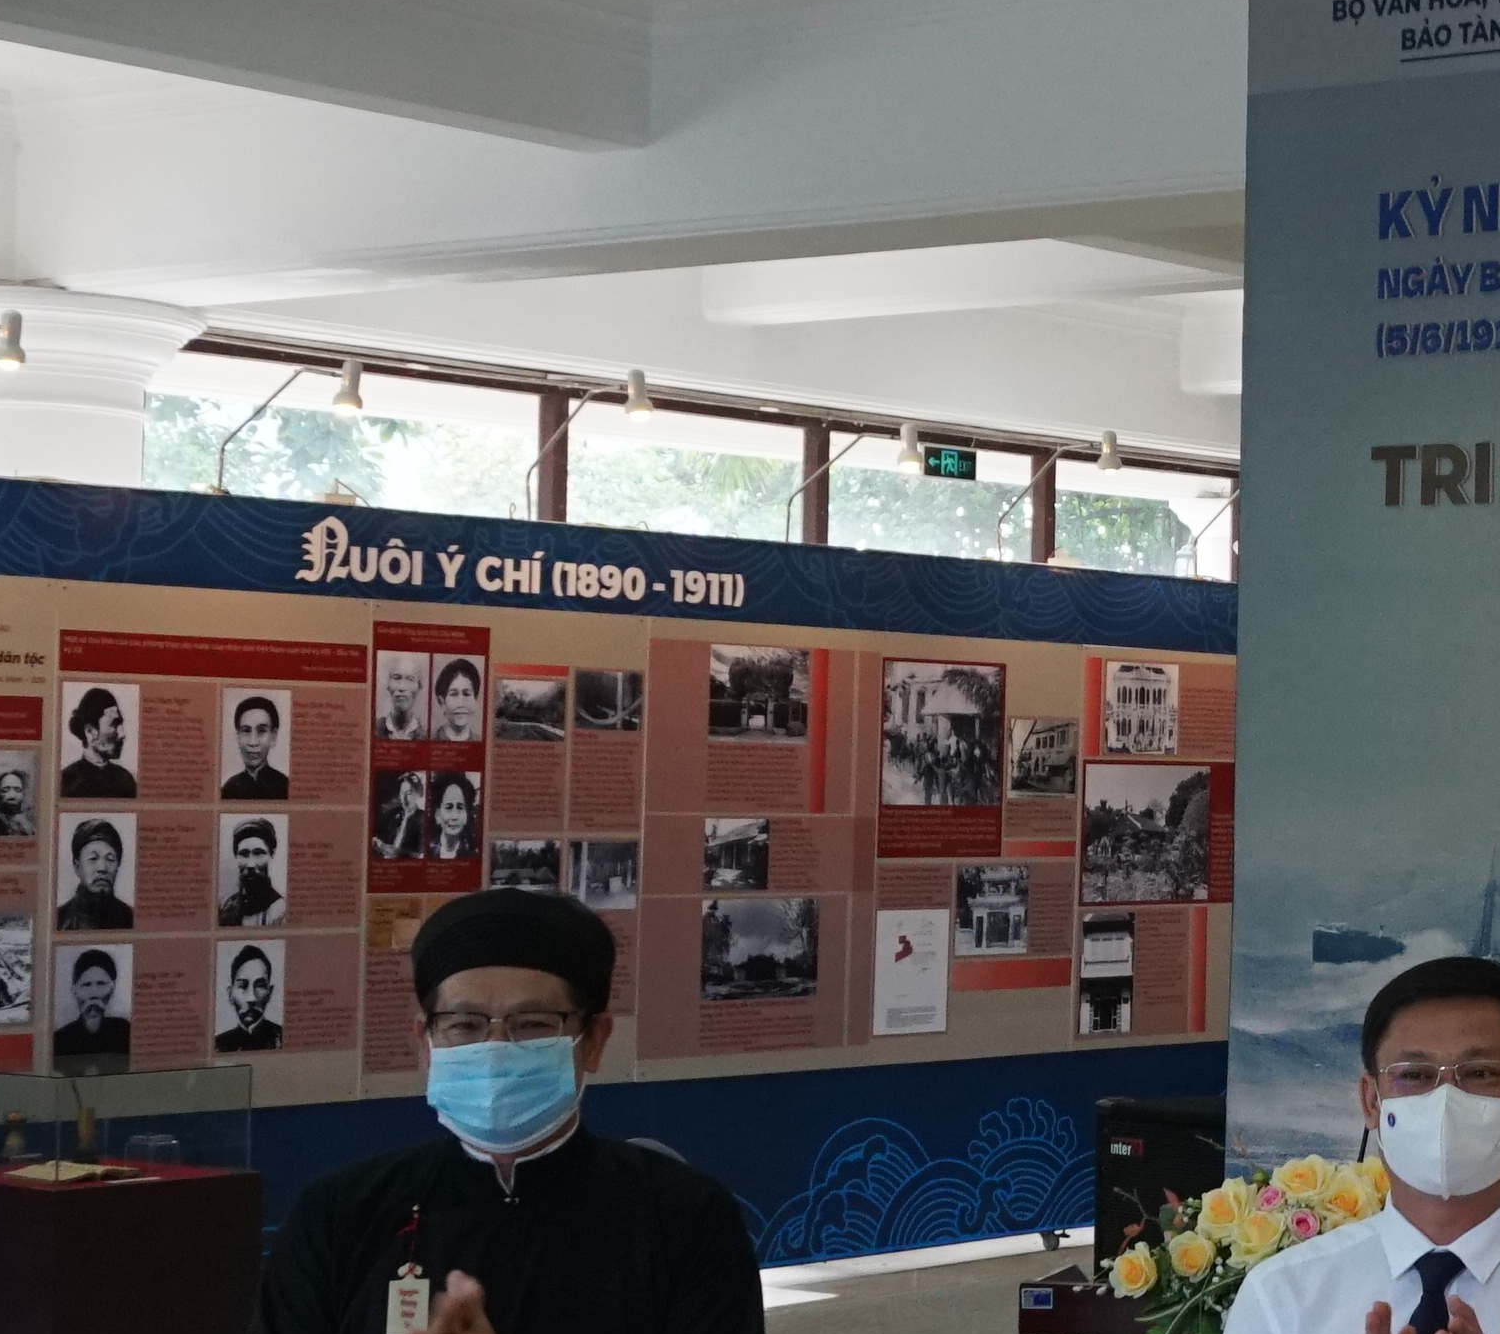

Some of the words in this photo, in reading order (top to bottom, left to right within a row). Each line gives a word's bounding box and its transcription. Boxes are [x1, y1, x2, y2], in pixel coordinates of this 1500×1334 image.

[1401, 18, 1451, 51] BẢO
[1378, 176, 1456, 240] KỶ
[1377, 253, 1474, 300] NGÀY
[437, 544, 465, 588] Ý
[476, 550, 542, 595] CHÍ
[553, 560, 646, 602] (1890
[670, 569, 745, 608] 1911)
